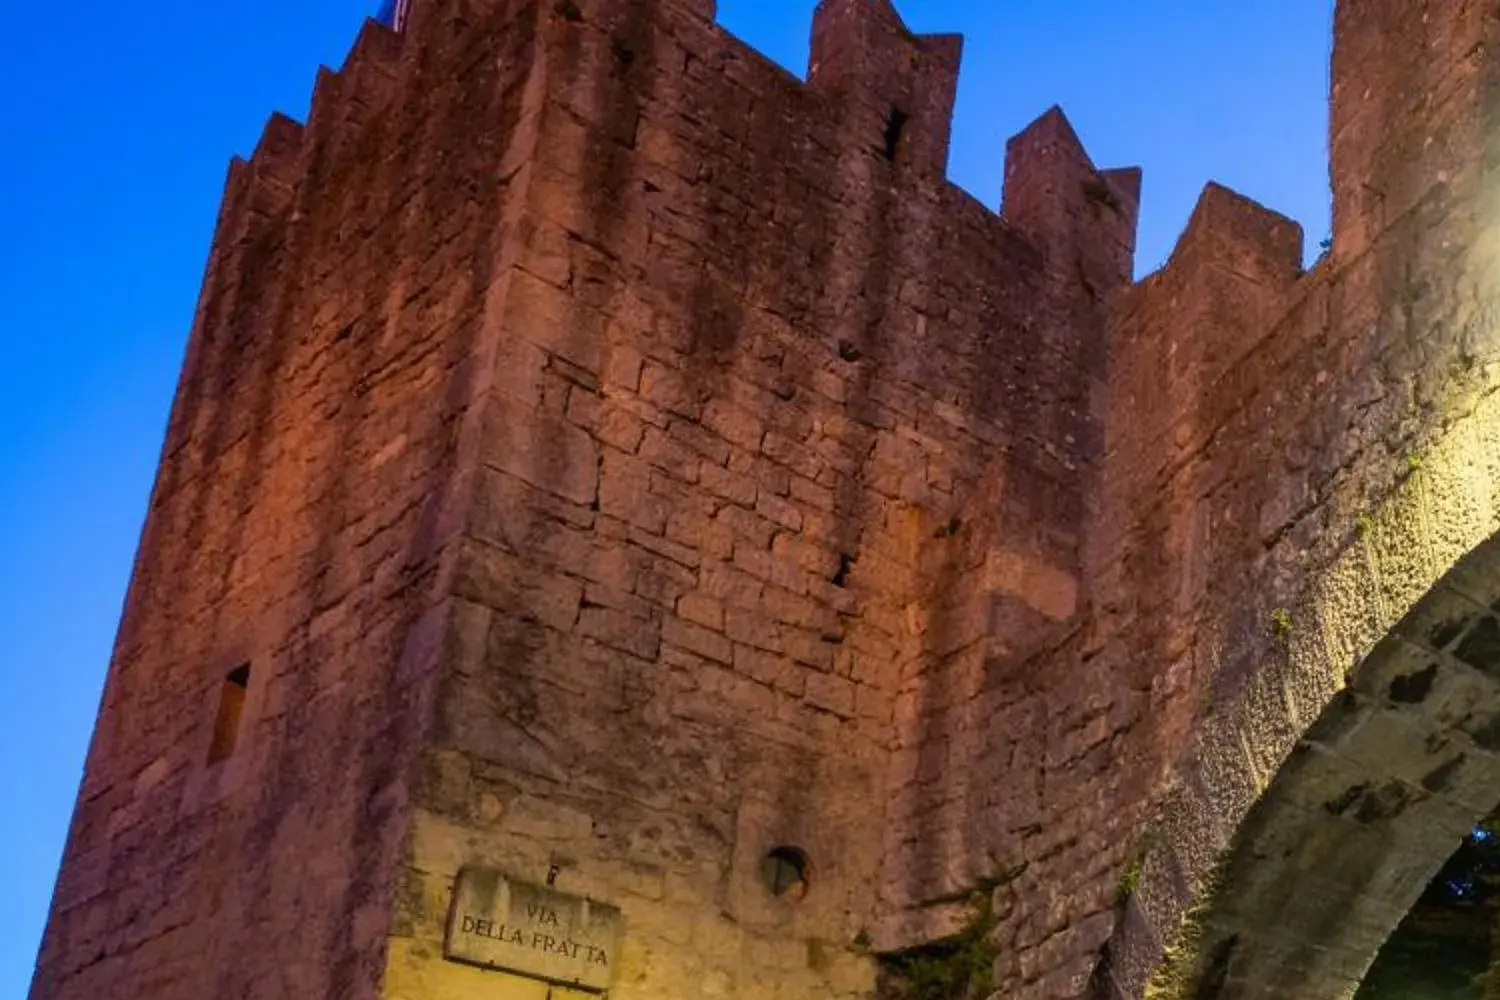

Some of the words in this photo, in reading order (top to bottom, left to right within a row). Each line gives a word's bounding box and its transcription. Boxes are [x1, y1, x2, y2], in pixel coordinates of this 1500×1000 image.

[527, 903, 559, 926] VIA
[462, 915, 522, 944] DELLA
[532, 932, 608, 965] FRATTA
